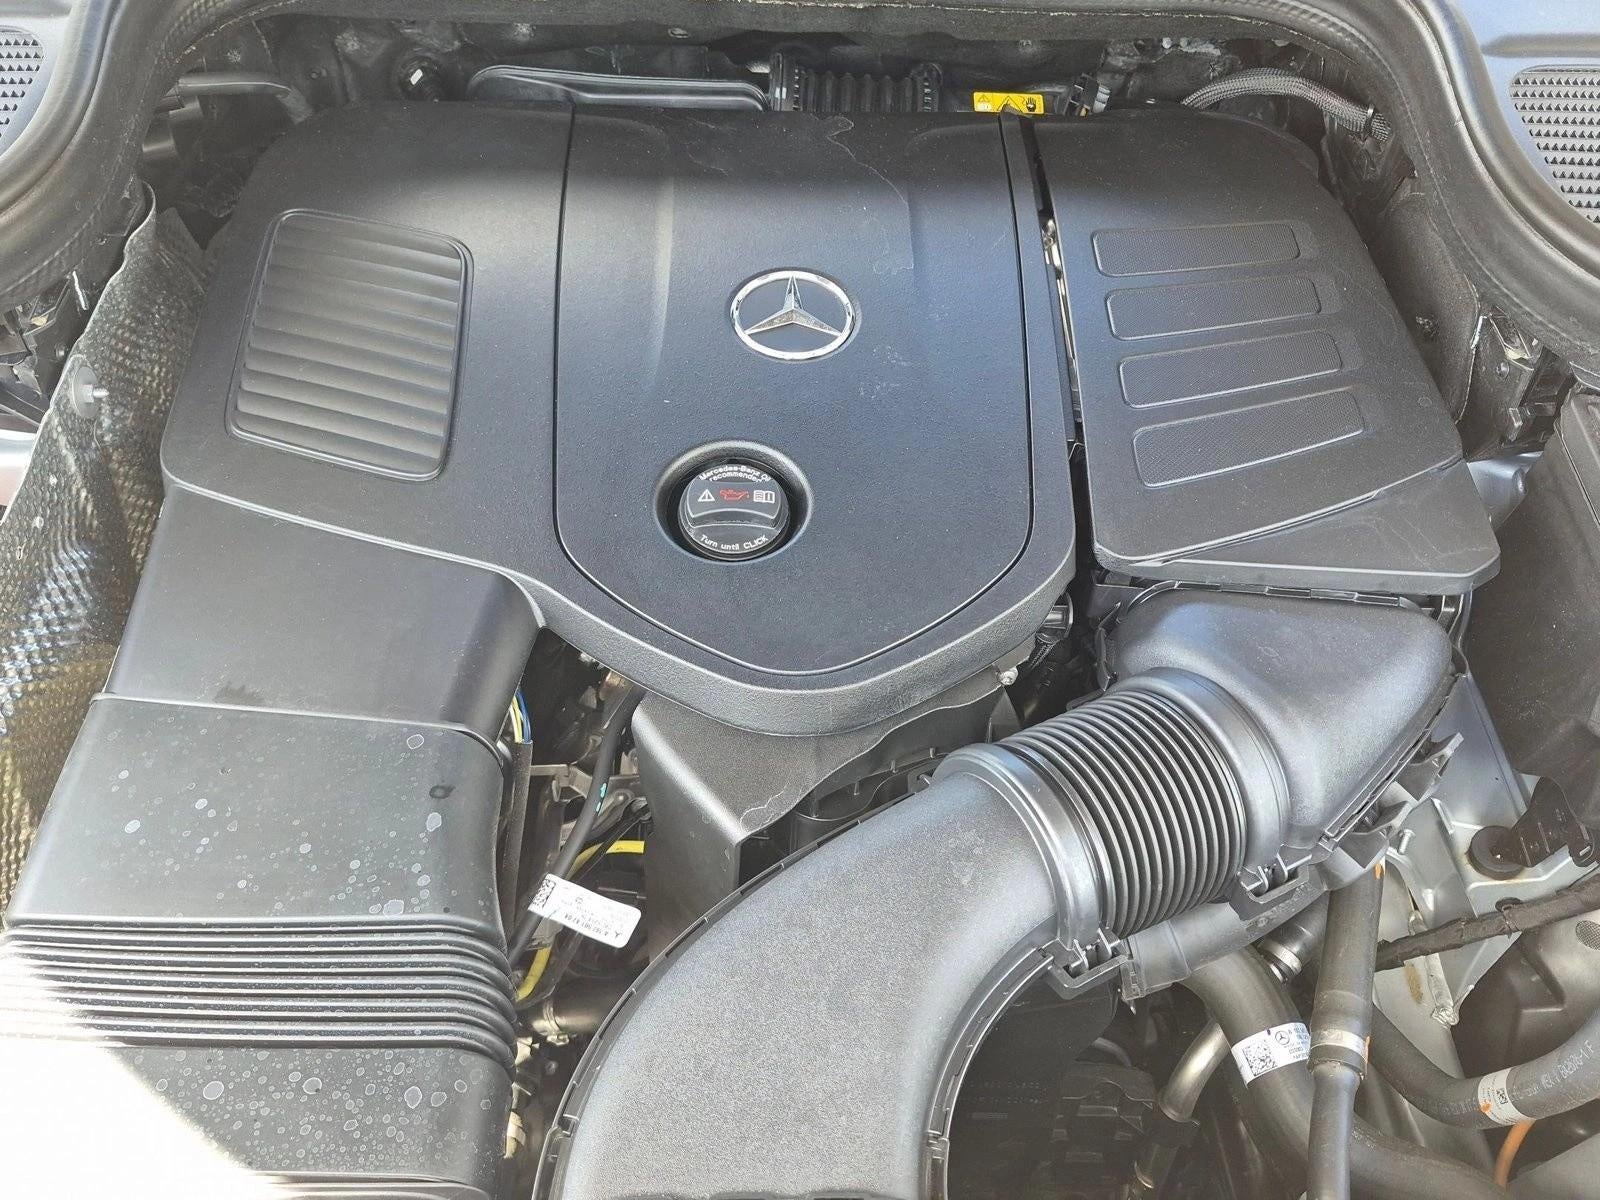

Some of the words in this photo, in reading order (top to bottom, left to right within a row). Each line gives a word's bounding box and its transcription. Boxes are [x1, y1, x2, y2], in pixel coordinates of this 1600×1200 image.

[699, 465, 760, 480] Mercedes-Benz
[700, 534, 718, 547] Turn
[743, 534, 768, 549] CLICK
